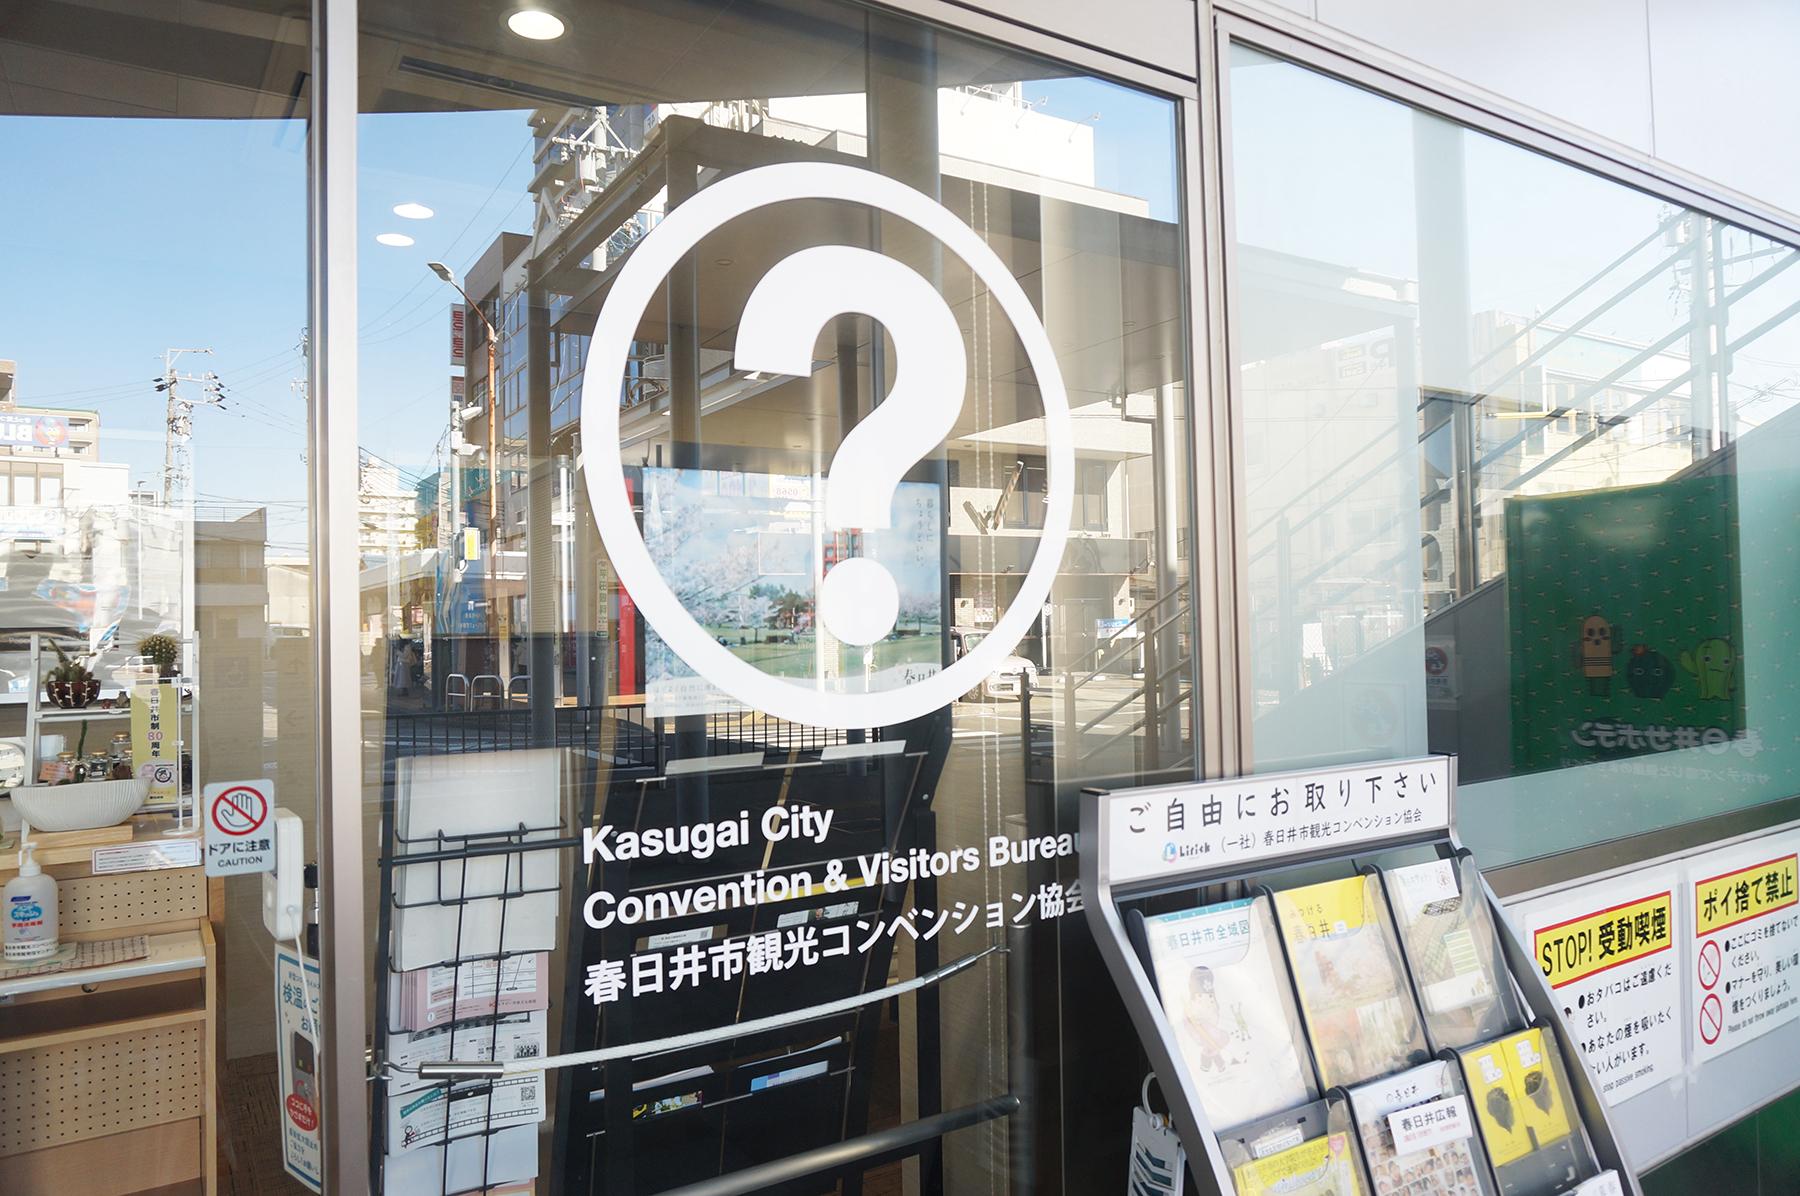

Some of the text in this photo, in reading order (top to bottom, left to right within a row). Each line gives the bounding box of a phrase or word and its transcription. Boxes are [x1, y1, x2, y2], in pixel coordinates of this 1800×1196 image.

[1129, 771, 1437, 834] ご自由にお取り下さい
[208, 838, 271, 856] ドアに注意
[217, 856, 263, 868] CAUTION
[583, 804, 834, 864] Kasugai City
[583, 869, 812, 930] Convention
[823, 859, 849, 894] &
[858, 847, 980, 887] Visitors
[1703, 867, 1794, 922] ポイ捨て禁止
[584, 878, 1085, 1006] 春日井市観光コンベンション協会
[1542, 906, 1667, 977] STOP! 受動喫煙
[1587, 1011, 1607, 1029] さい。
[1401, 1105, 1457, 1132] 春日井広報
